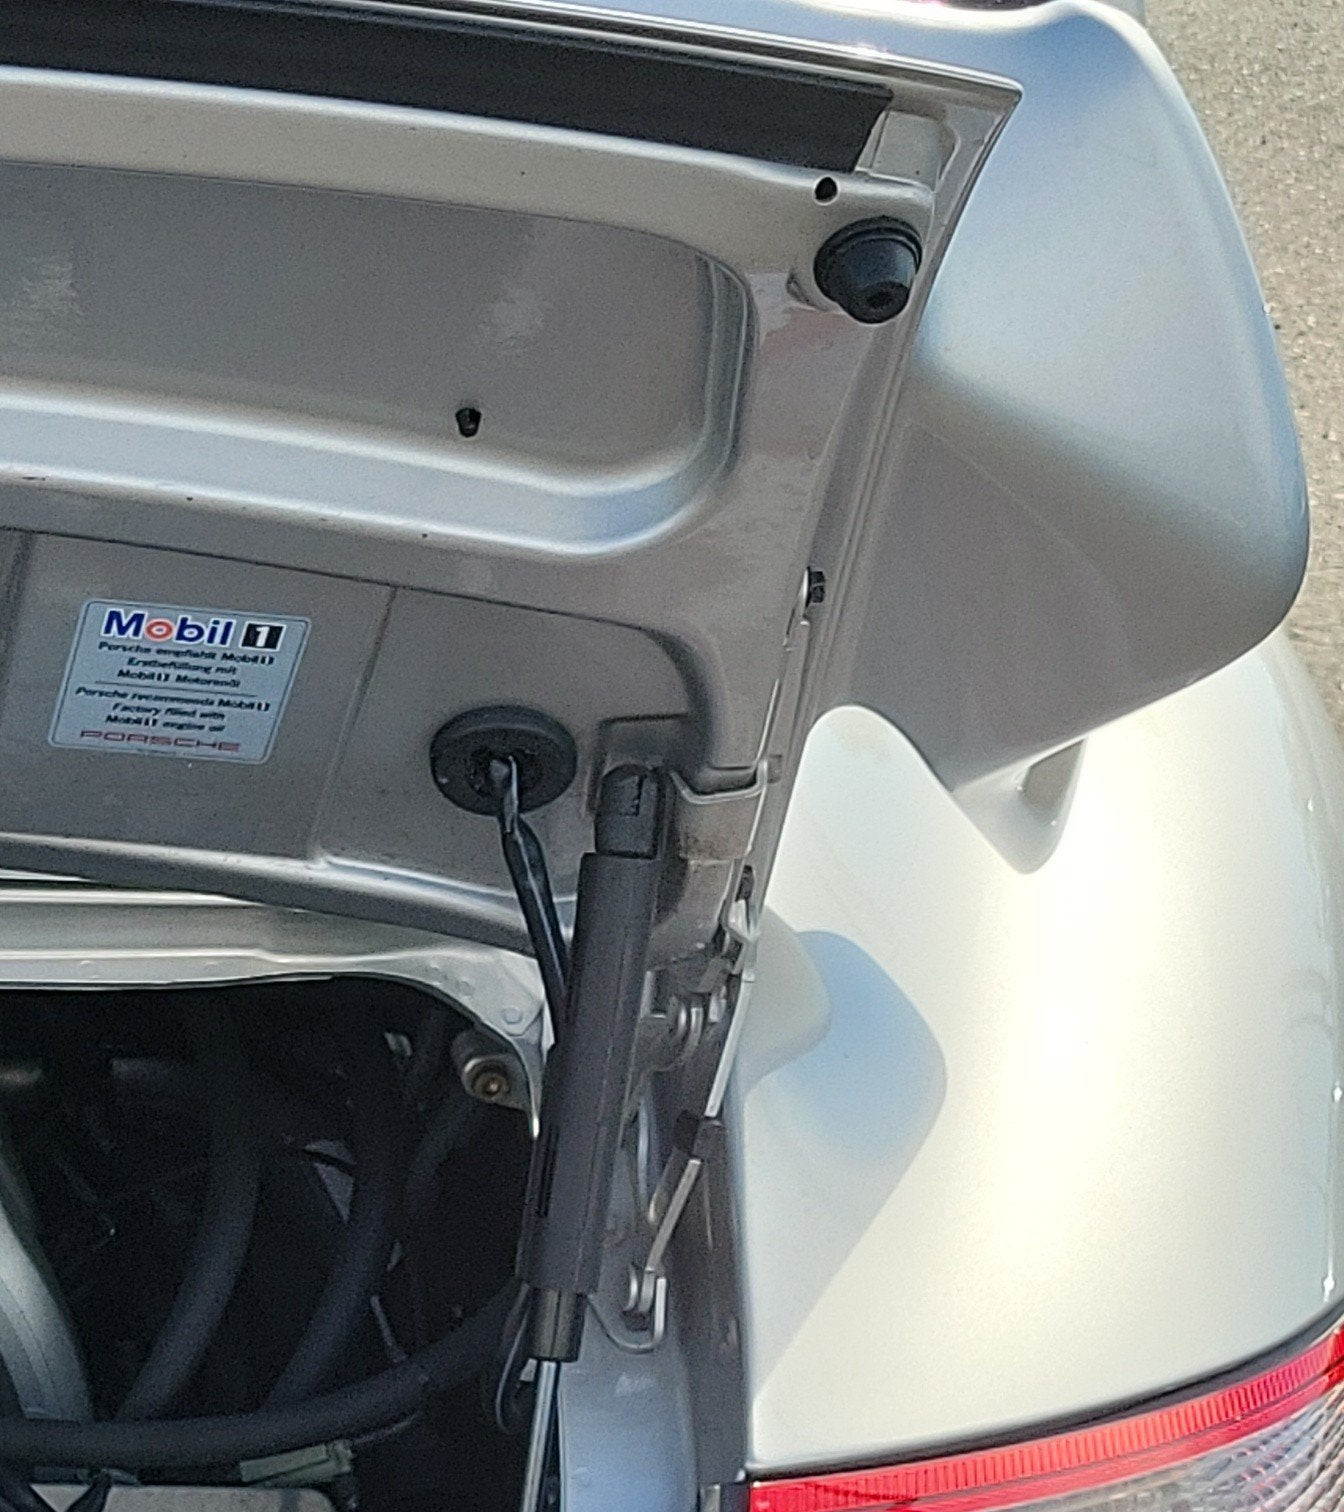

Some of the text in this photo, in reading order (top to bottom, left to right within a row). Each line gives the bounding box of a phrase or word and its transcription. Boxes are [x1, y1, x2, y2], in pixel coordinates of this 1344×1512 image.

[102, 609, 234, 646] Mobil
[98, 641, 151, 654] Porsche
[117, 669, 156, 681] Mobil
[214, 665, 237, 675] mit
[75, 686, 129, 700] Porsche
[112, 702, 161, 716] Factory
[105, 714, 143, 725] Mobil
[162, 721, 205, 731] engine
[79, 731, 241, 751] PORSCHE
